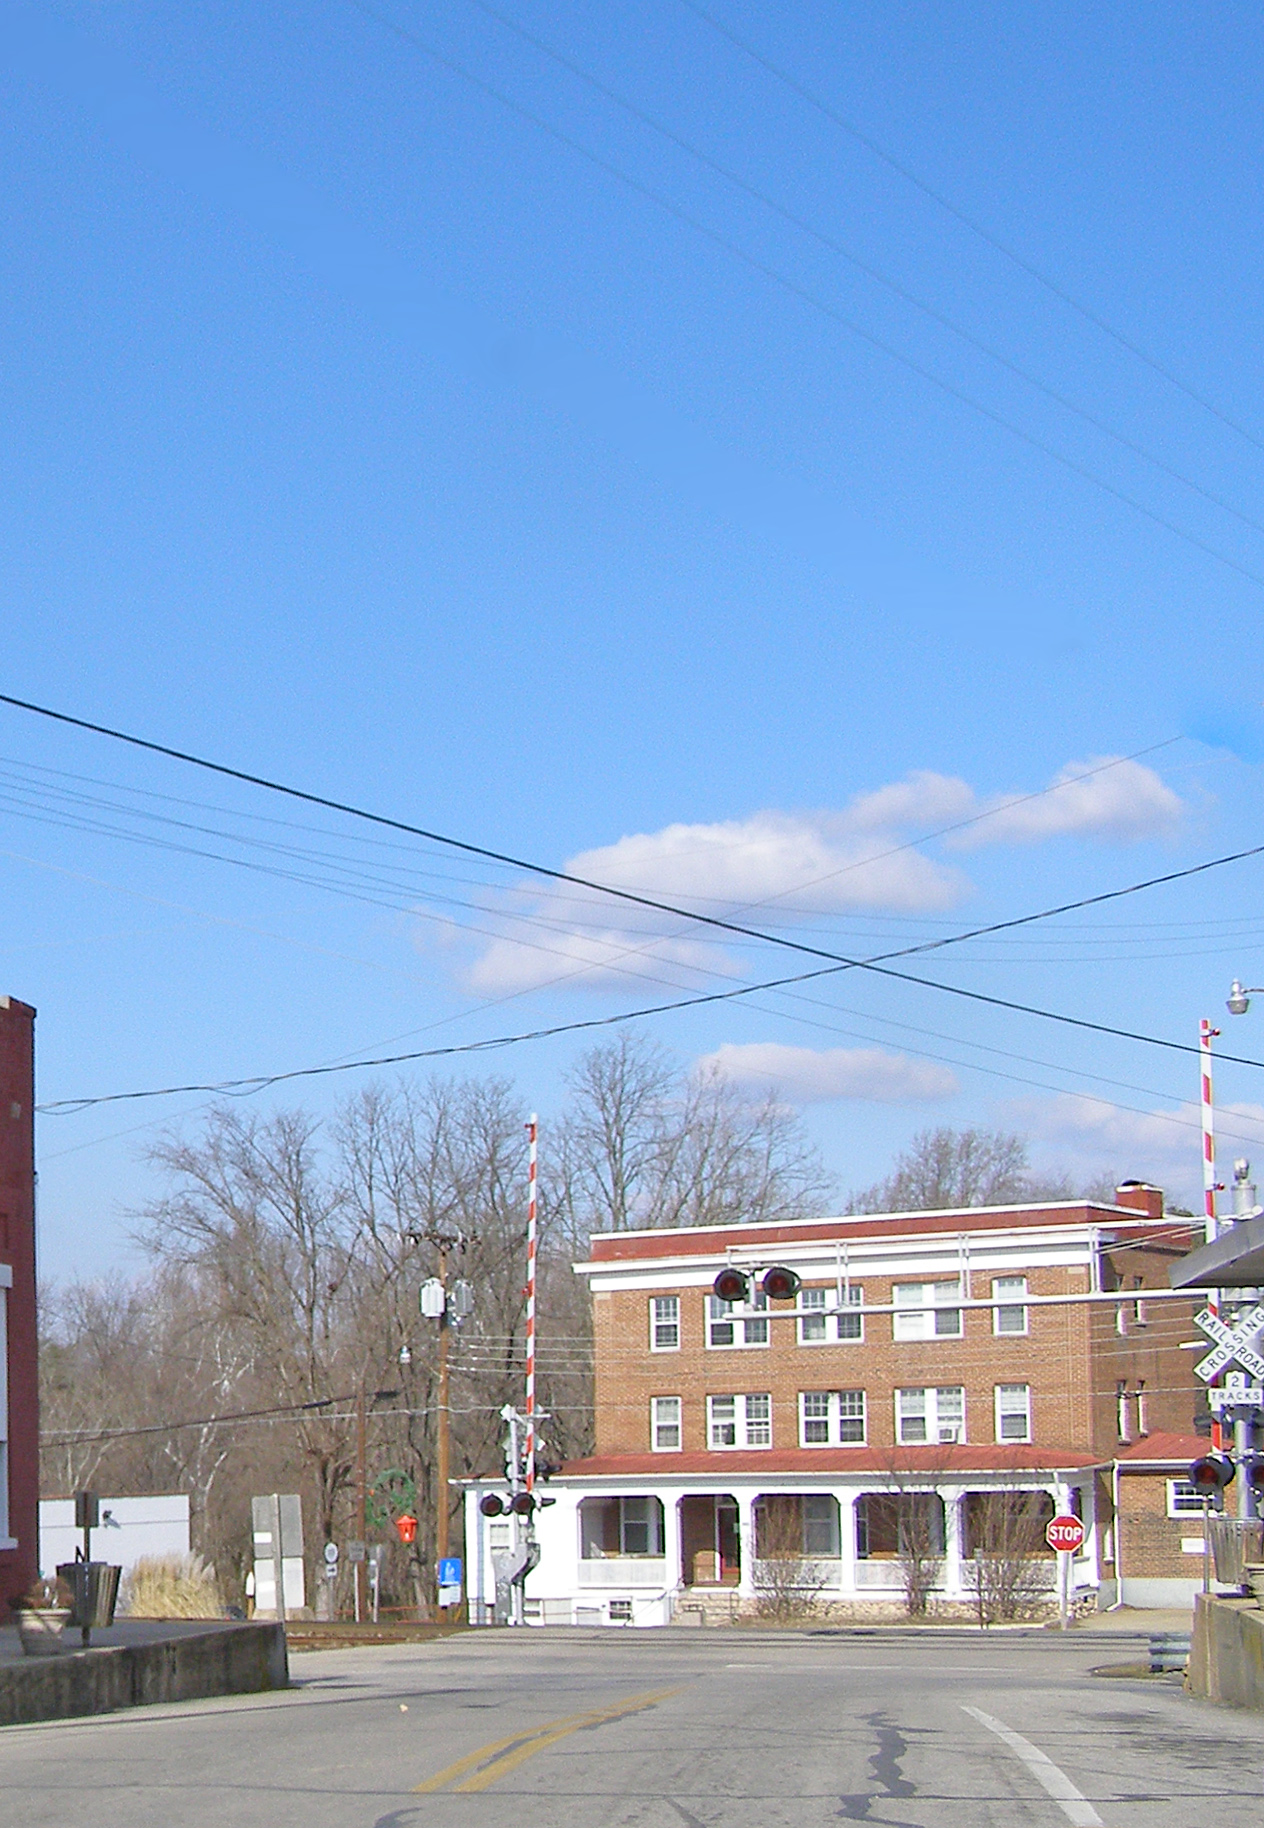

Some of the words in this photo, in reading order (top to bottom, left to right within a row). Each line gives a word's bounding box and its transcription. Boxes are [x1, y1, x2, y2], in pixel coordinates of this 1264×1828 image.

[1199, 1311, 1264, 1377] CROSSING
[1231, 1375, 1239, 1387] 2
[1211, 1391, 1260, 1400] TRACKS
[1049, 1525, 1082, 1541] STOP
